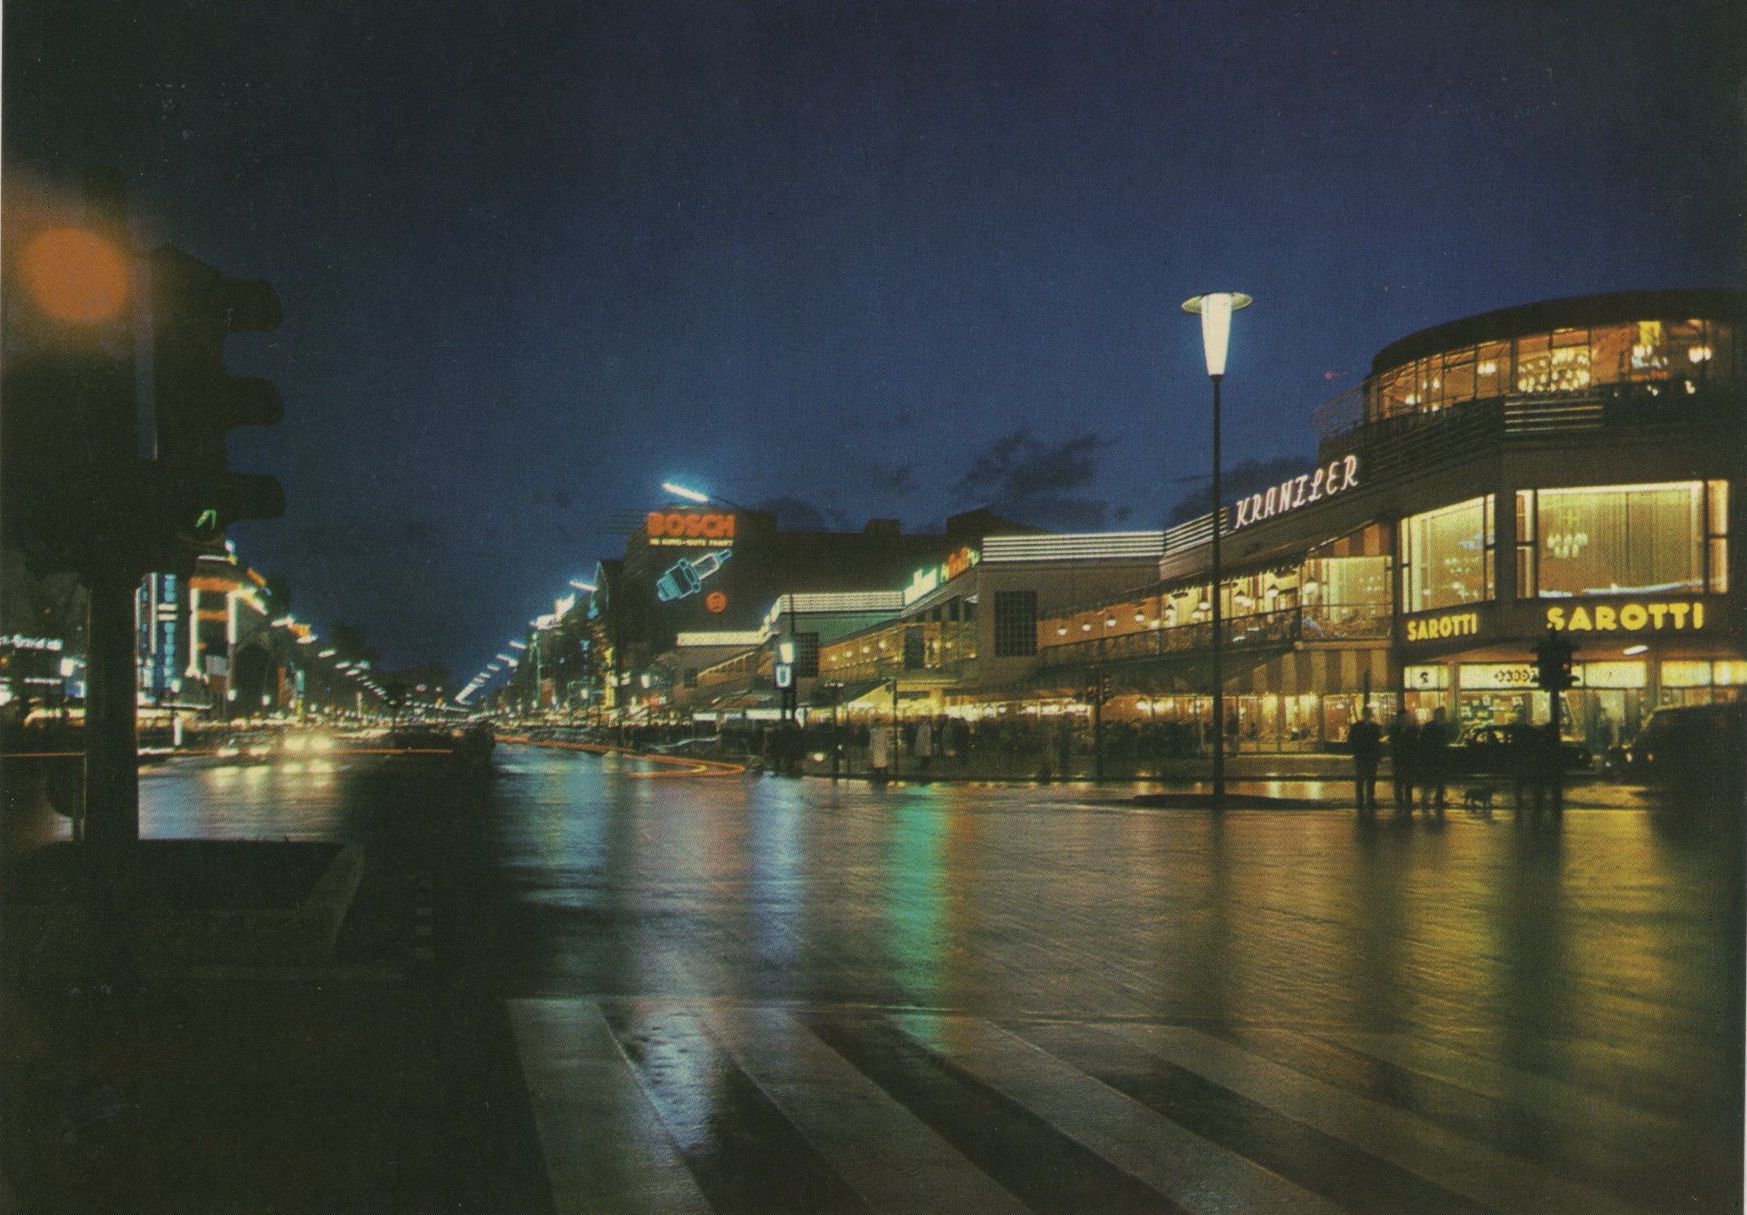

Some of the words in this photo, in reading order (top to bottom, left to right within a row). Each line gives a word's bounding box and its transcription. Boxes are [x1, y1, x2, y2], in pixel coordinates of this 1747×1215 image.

[1234, 454, 1359, 529] KRANZLER
[646, 512, 736, 538] BOSCH
[1407, 612, 1477, 641] SAROTTI
[1547, 602, 1704, 631] SAROTTI
